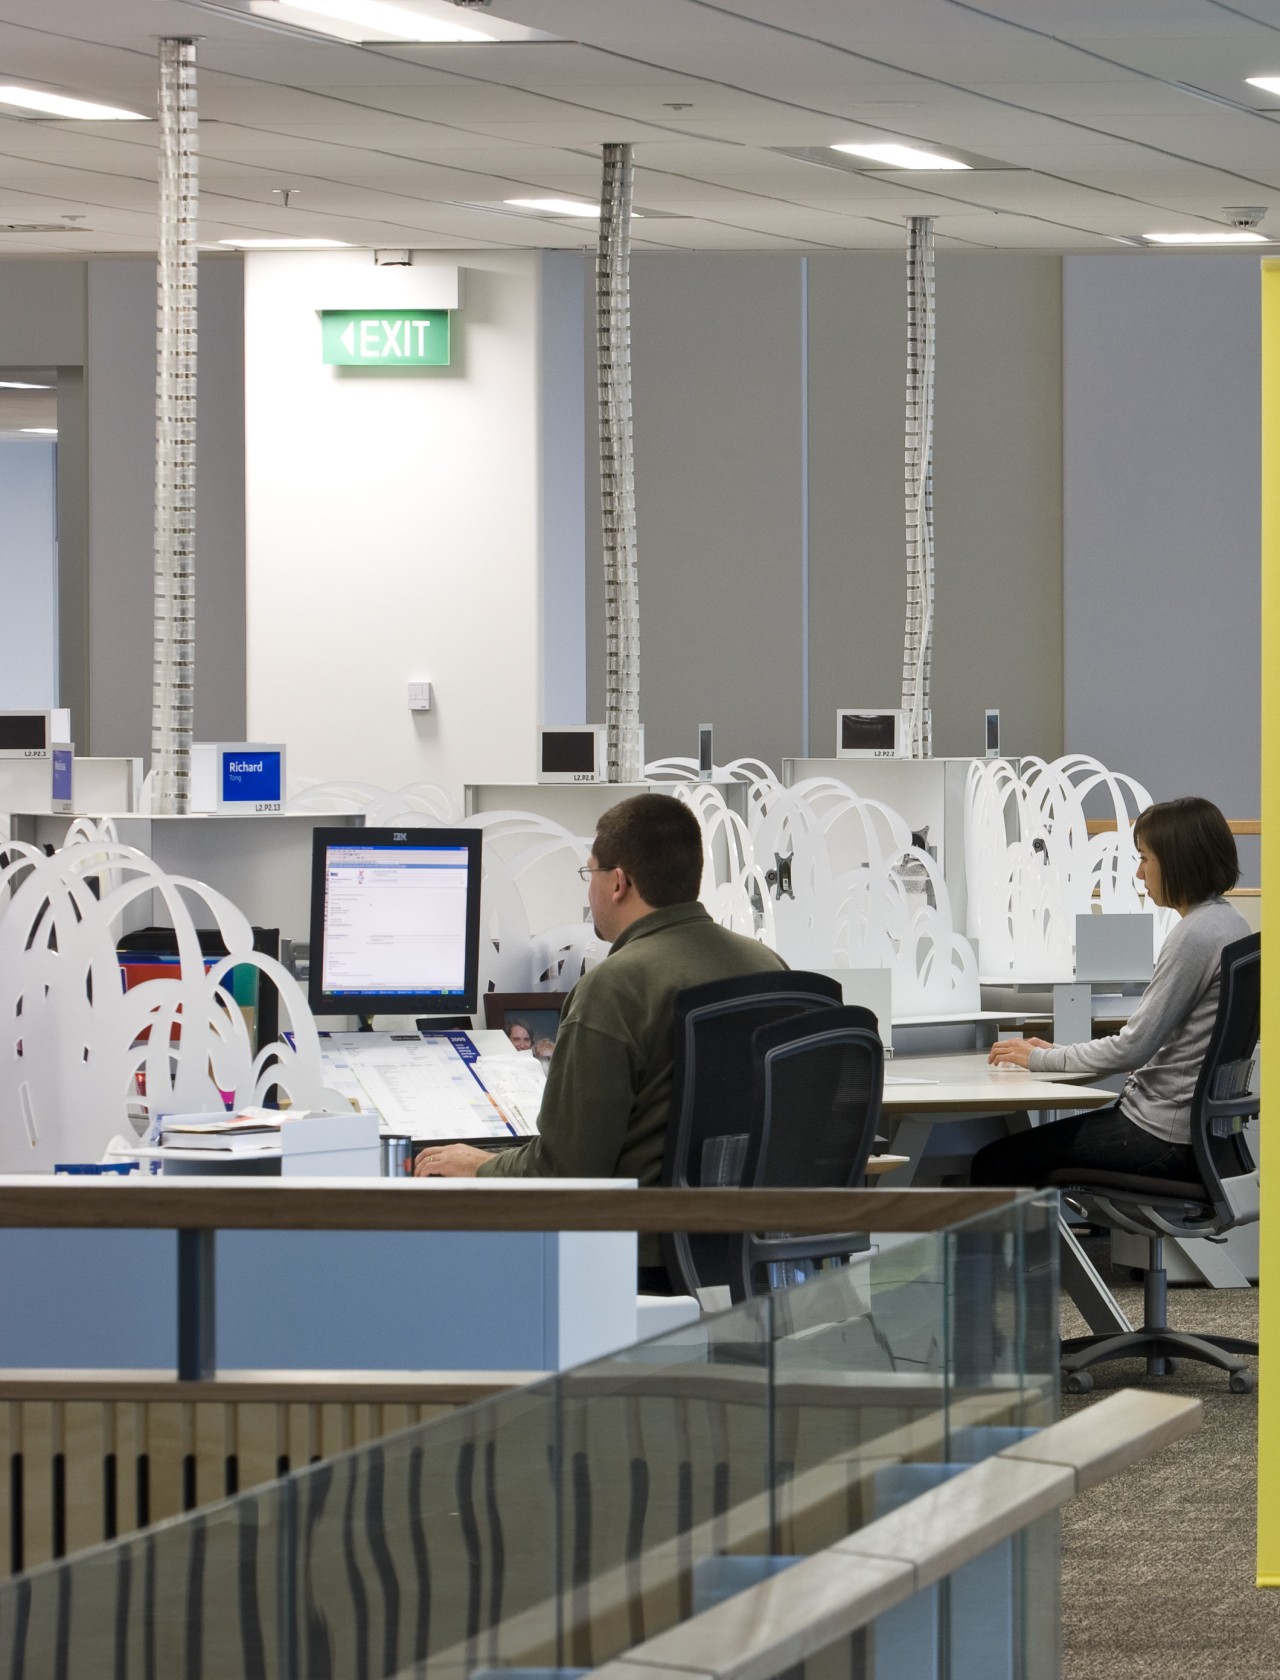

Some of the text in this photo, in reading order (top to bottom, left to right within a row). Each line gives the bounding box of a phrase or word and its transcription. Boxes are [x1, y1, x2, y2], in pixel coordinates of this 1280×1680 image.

[360, 320, 431, 357] EXIT
[229, 761, 263, 772] Richard
[229, 774, 242, 783] Tong
[255, 803, 281, 812] L2.P2.13
[393, 832, 408, 841] IBM
